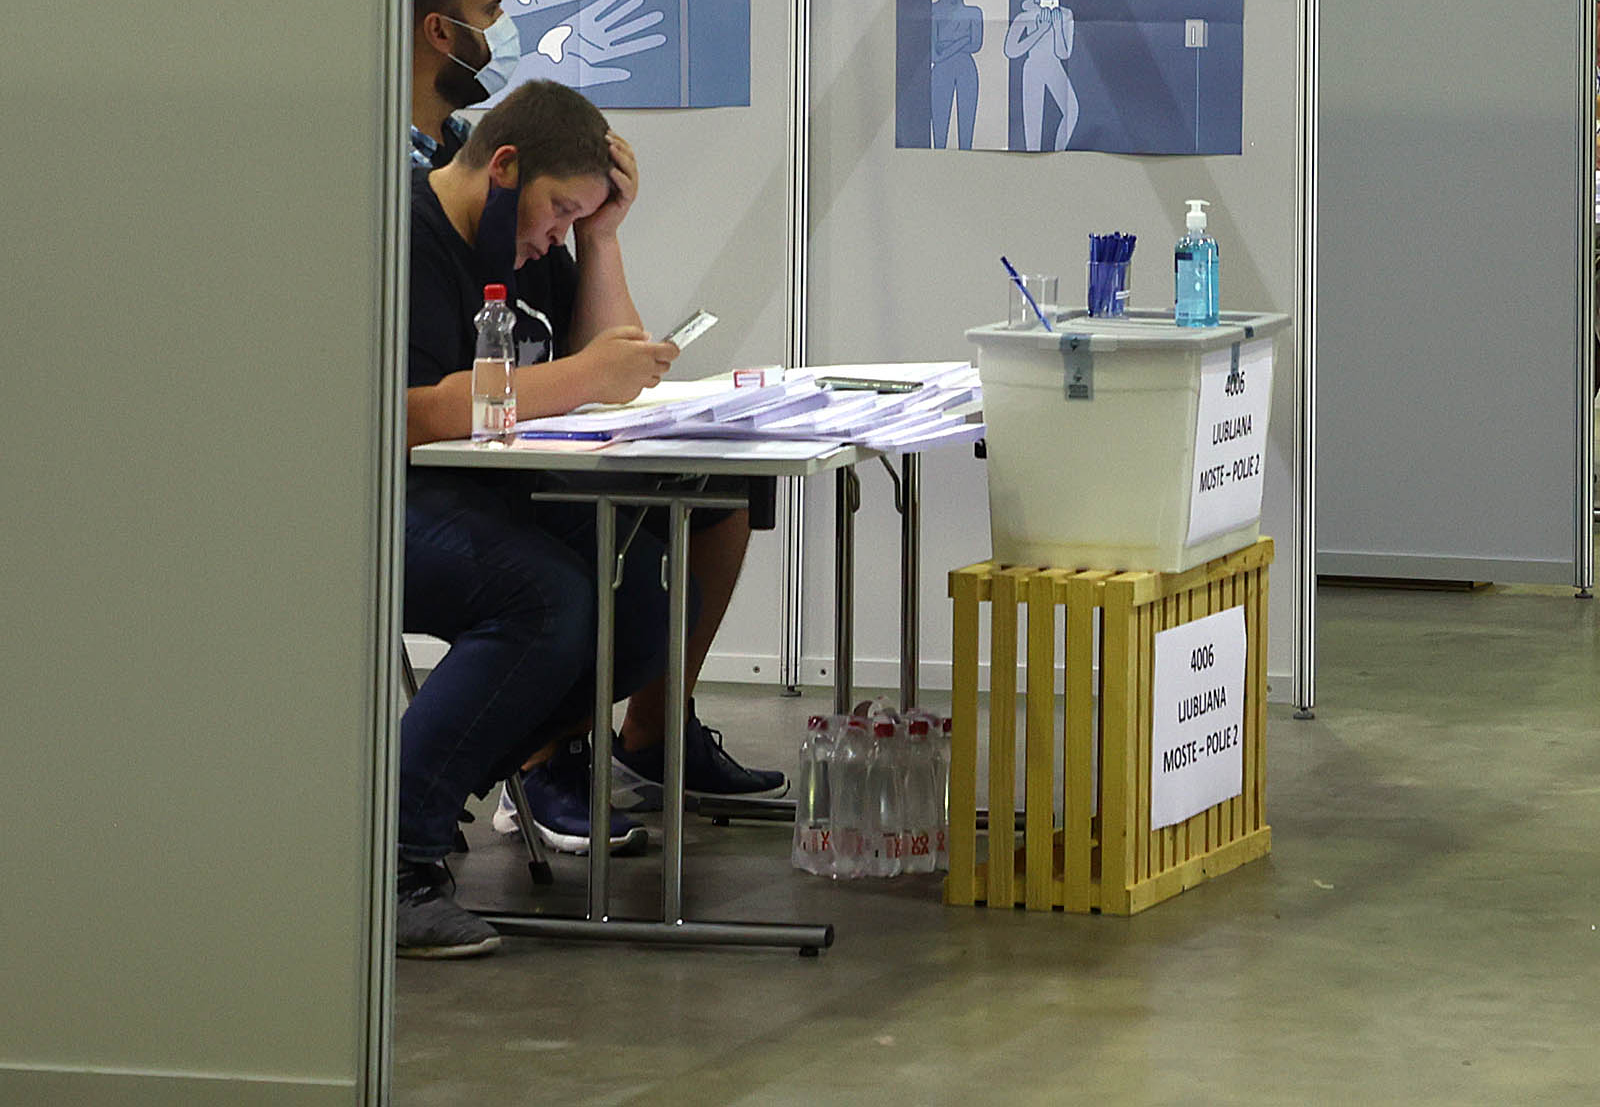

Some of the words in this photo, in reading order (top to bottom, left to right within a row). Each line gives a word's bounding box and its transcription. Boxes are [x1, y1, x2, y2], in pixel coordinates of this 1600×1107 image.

[1224, 370, 1246, 397] 4006
[1212, 413, 1253, 445] LJUBLJANA
[1198, 464, 1225, 492] MOSTE
[1232, 455, 1254, 482] POLJE
[1254, 452, 1261, 476] 2
[1190, 643, 1215, 673] 4006
[1177, 686, 1228, 723] LJUBLJANA
[1163, 740, 1198, 774] MOSTE
[1206, 727, 1233, 757] POLJE
[1232, 723, 1239, 747] 2
